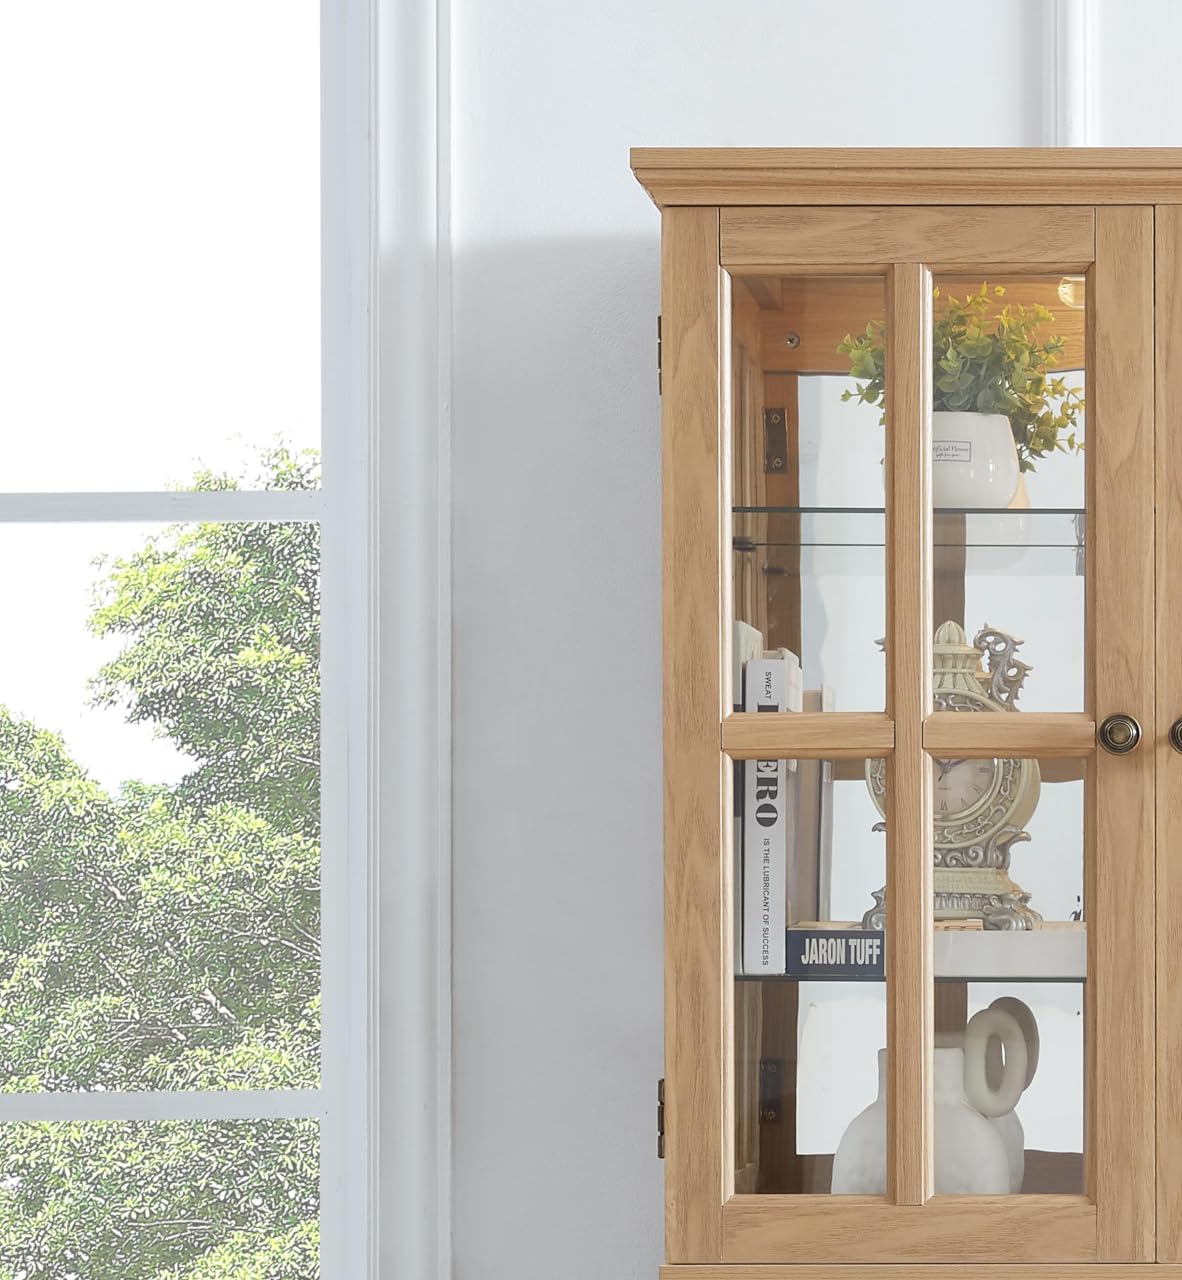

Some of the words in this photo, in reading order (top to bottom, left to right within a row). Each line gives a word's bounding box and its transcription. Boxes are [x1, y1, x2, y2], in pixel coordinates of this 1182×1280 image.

[764, 671, 772, 700] SWEAT
[763, 838, 770, 846] IS
[762, 865, 770, 913] LUBRICANT
[762, 914, 770, 926] OF
[762, 927, 770, 966] SUCCESS
[801, 938, 846, 965] JARON
[848, 938, 881, 965] TUFF
